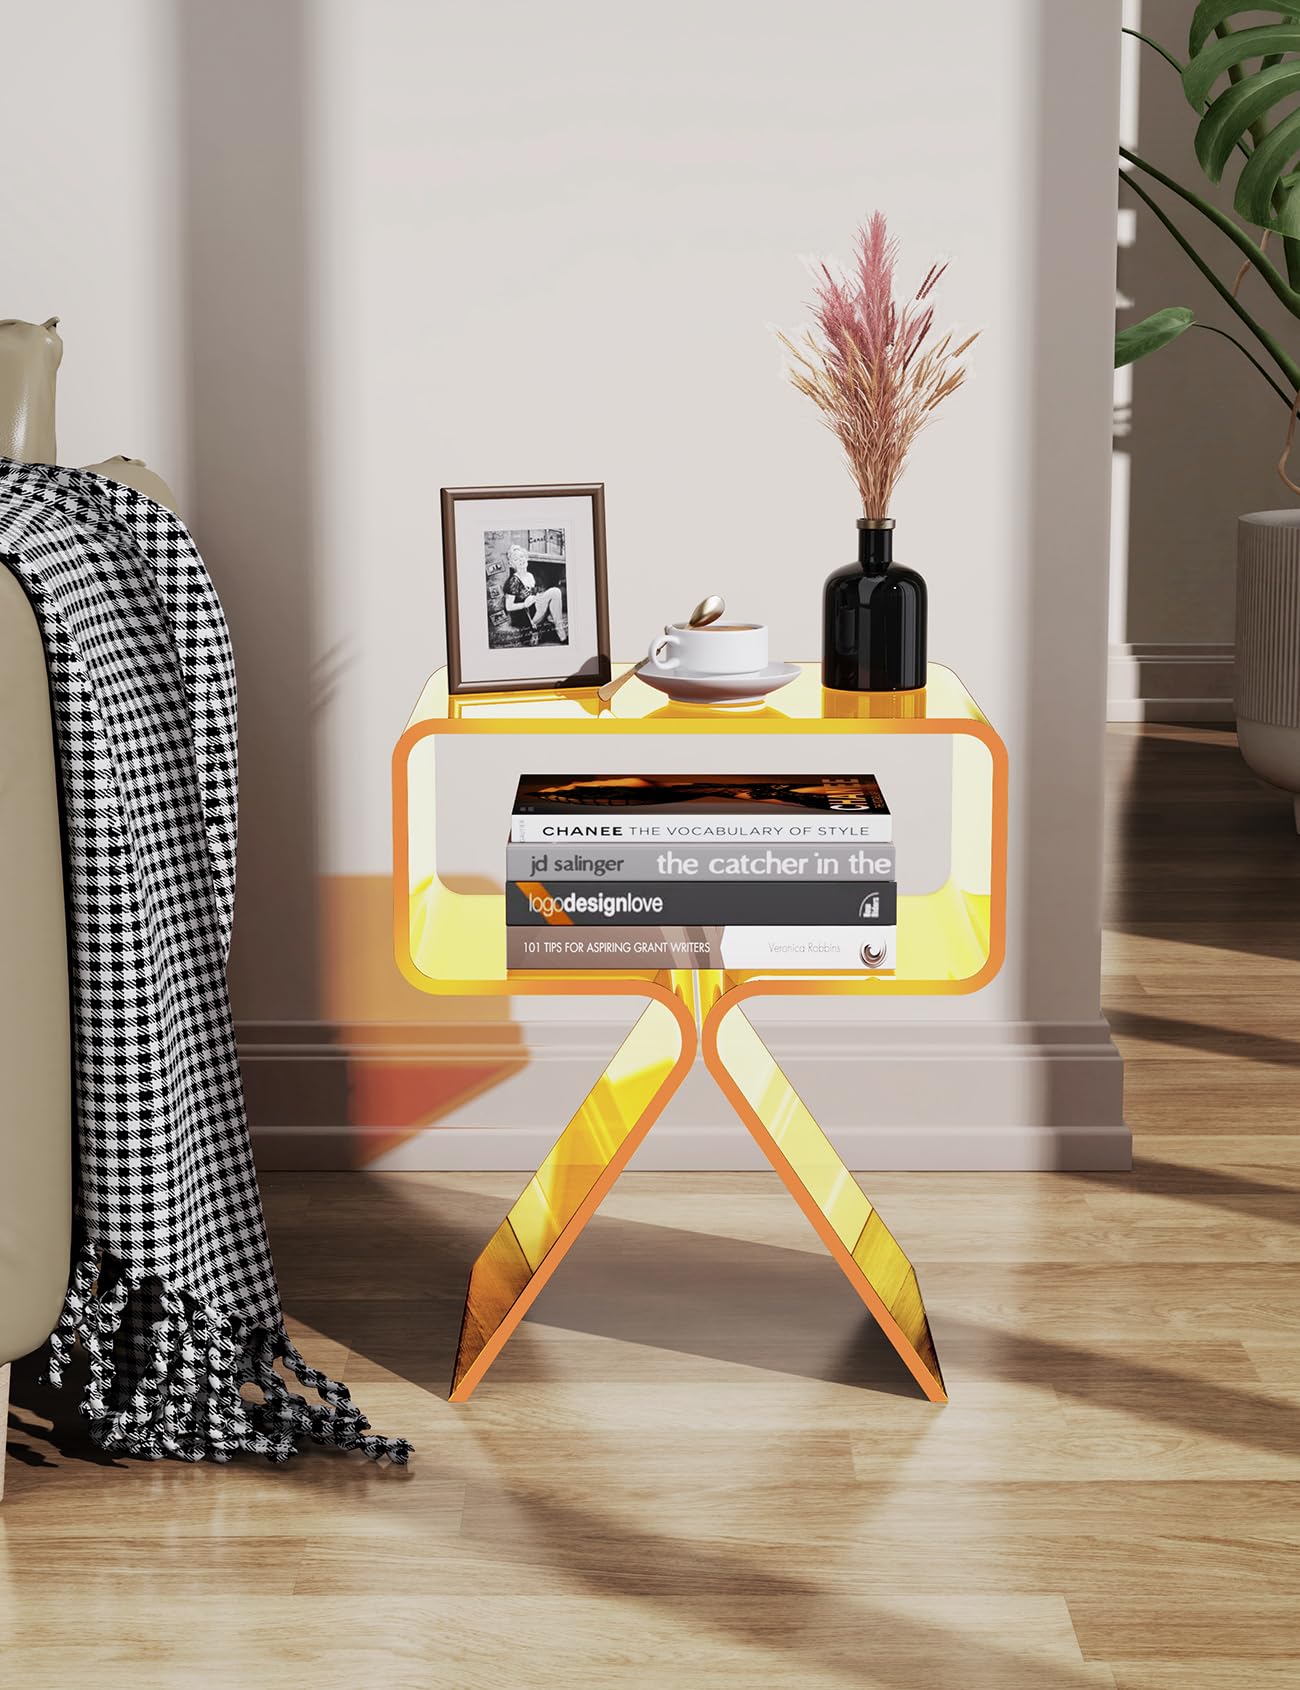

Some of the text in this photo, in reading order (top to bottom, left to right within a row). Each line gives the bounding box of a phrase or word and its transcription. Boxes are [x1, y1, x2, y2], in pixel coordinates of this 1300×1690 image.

[542, 826, 870, 836] CHANEE THE VOCABULARY OF STYLE
[530, 850, 892, 877] jd salinger the catcher in the
[528, 892, 663, 917] logodesignlove
[523, 942, 541, 953] 101
[544, 942, 562, 953] TIPS
[564, 942, 584, 953] FOR
[586, 942, 632, 953] ASPIRING
[633, 942, 668, 953] GRANT
[670, 942, 710, 953] WRITERS
[768, 942, 806, 953] Veronica
